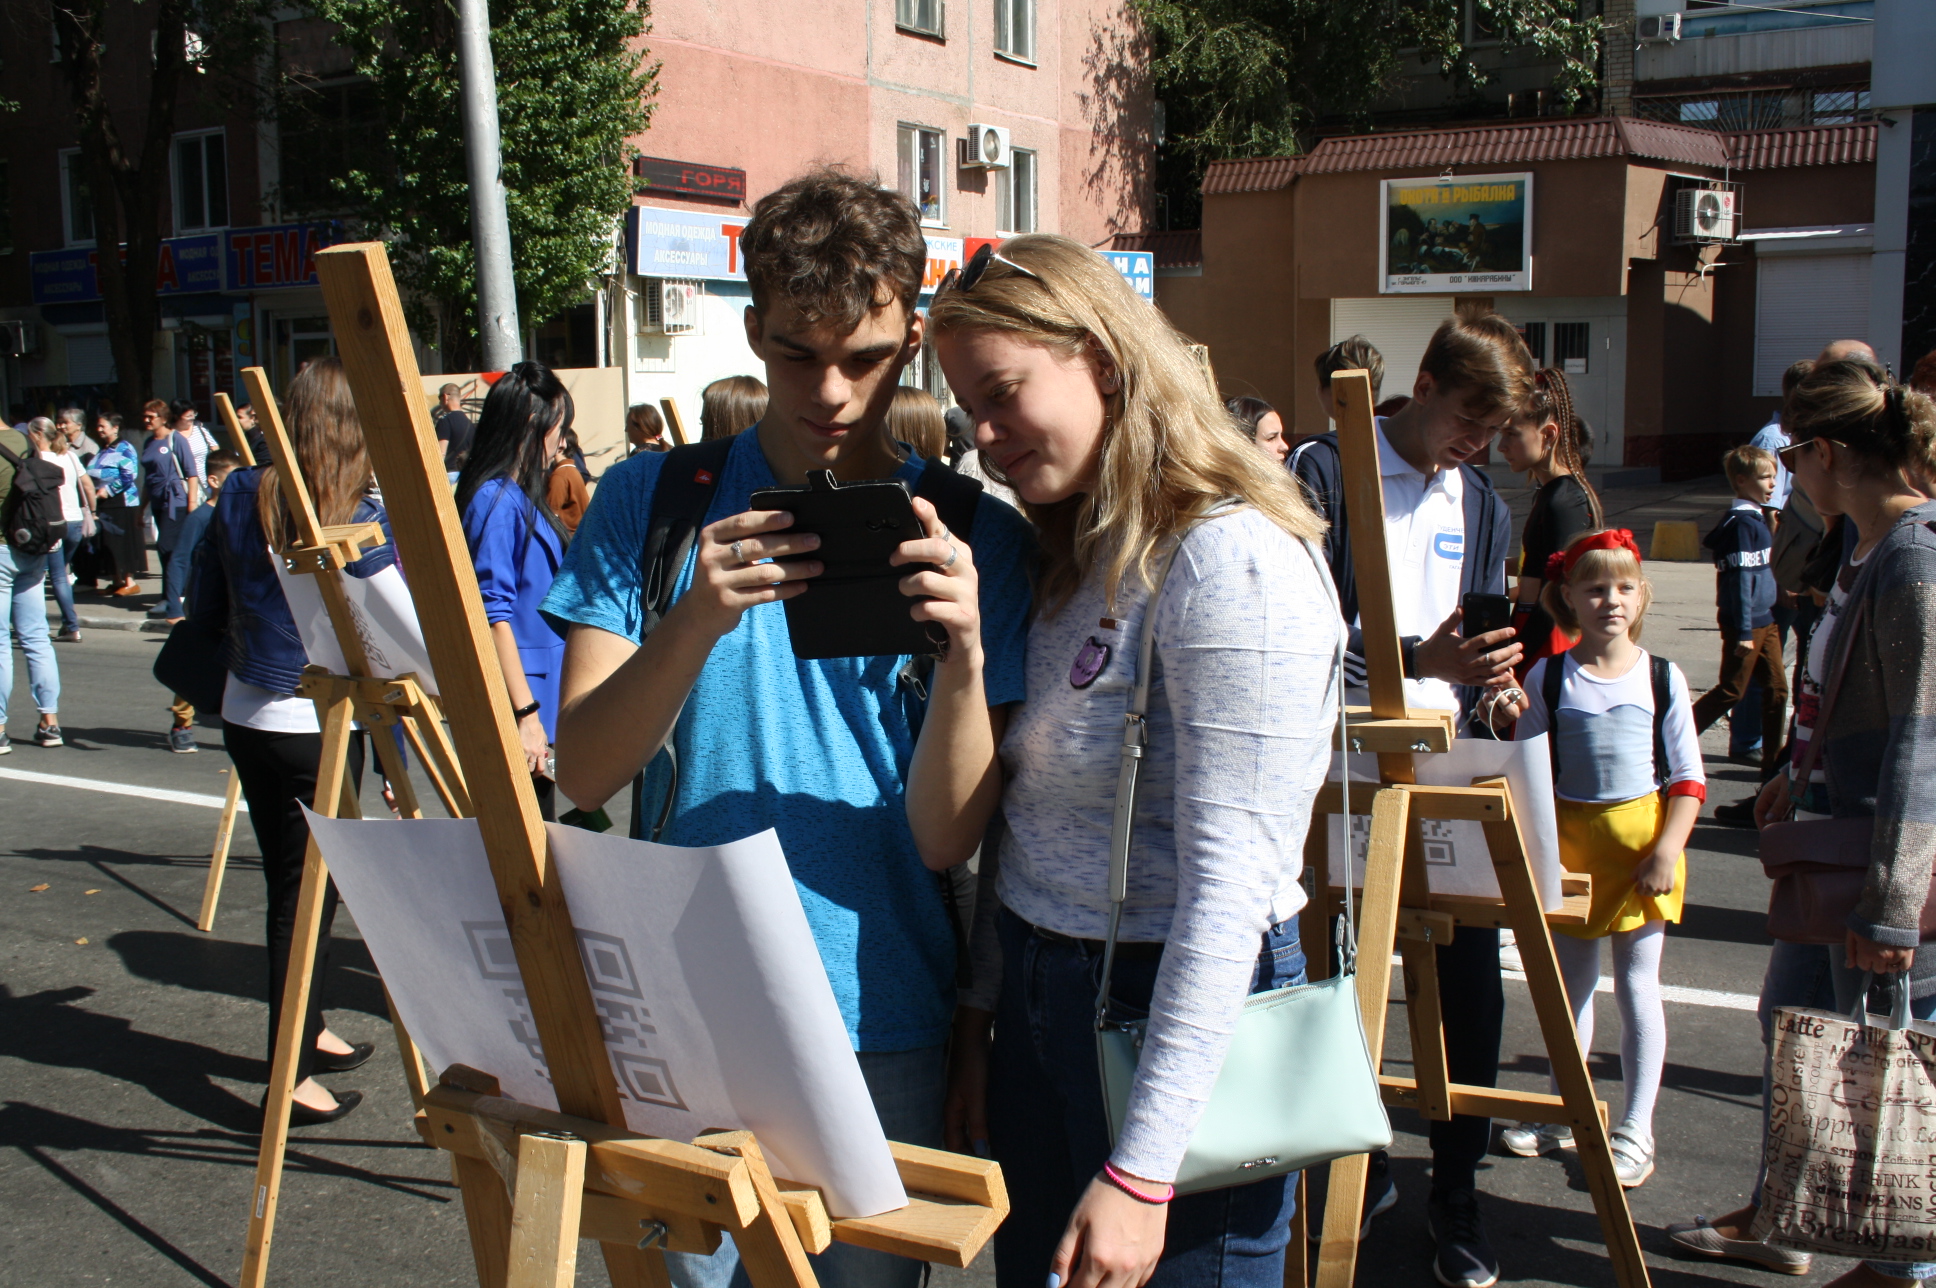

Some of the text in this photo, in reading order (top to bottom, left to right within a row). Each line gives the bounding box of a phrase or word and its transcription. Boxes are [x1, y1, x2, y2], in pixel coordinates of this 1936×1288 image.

[681, 169, 741, 191] ГОРЯ
[1399, 188, 1439, 206] ОХОТА
[1452, 184, 1516, 203] РЫБАЛКА
[645, 220, 717, 242] МОДНАЯ ОДЕЖДА
[925, 238, 958, 252] ЖСКИЕ
[653, 249, 709, 267] АКСЕССУАРЫ
[1772, 1010, 1825, 1039] Latte
[1842, 1026, 1888, 1048] milk
[1806, 1041, 1824, 1110] CHOCOLATE
[1881, 1155, 1925, 1165] Caffeine
[1859, 1168, 1921, 1189] DRINK
[1864, 1193, 1923, 1210] BEANS
[1799, 1209, 1936, 1253] Breakfast
